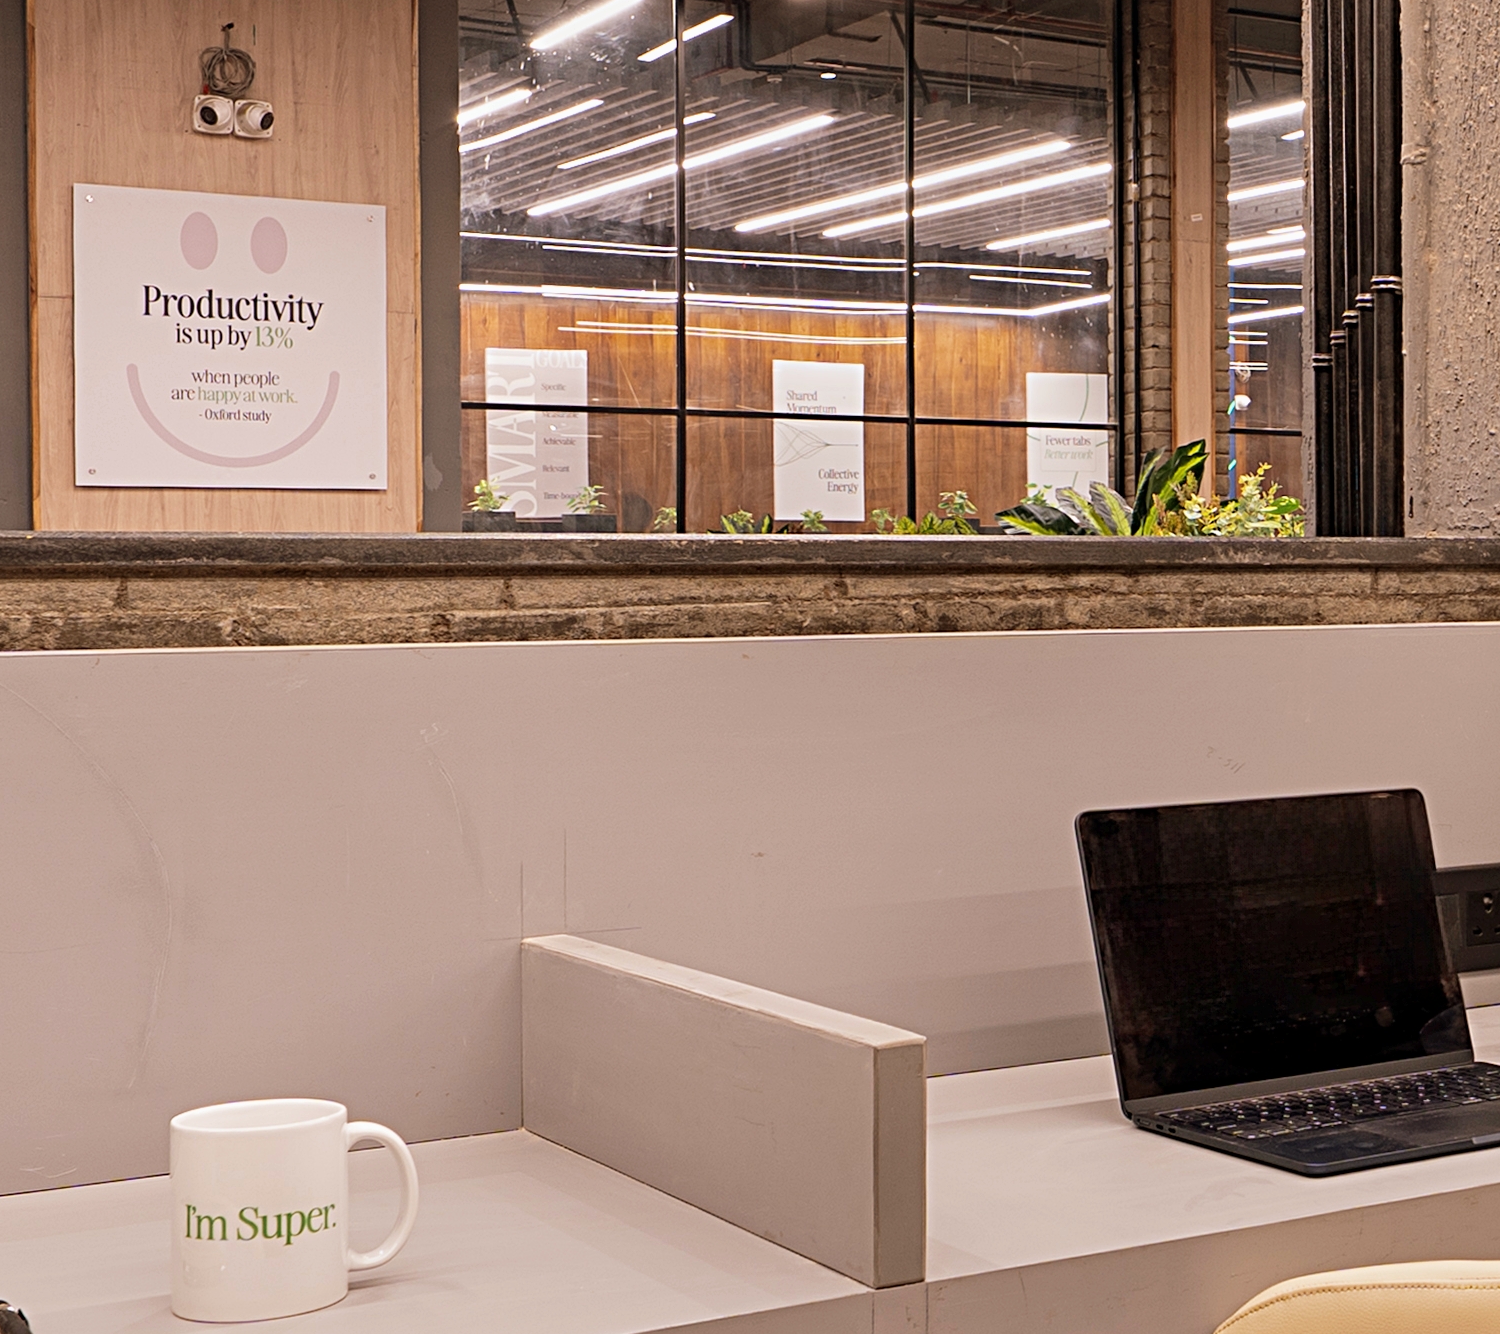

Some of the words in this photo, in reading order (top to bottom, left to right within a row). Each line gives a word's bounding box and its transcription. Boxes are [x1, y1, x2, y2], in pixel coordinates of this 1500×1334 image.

[142, 284, 324, 331] Productivity
[176, 323, 193, 344] is
[196, 328, 223, 350] up
[228, 324, 252, 351] by
[255, 326, 294, 349] 13%
[191, 369, 231, 385] when
[234, 371, 280, 388] people
[171, 388, 195, 400] are
[198, 386, 241, 405] happy
[243, 389, 256, 402] at
[257, 389, 298, 404] work.
[786, 390, 818, 401] Shared
[205, 408, 240, 421] Oxford
[242, 410, 272, 424] study
[786, 403, 837, 415] Momentum
[1045, 435, 1070, 446] Fewer
[1072, 436, 1091, 446] tabs
[1044, 449, 1070, 459] Better
[818, 468, 860, 480] Collective
[827, 481, 859, 494] Energy
[184, 1203, 228, 1241] I'm
[237, 1203, 336, 1247] Super.
